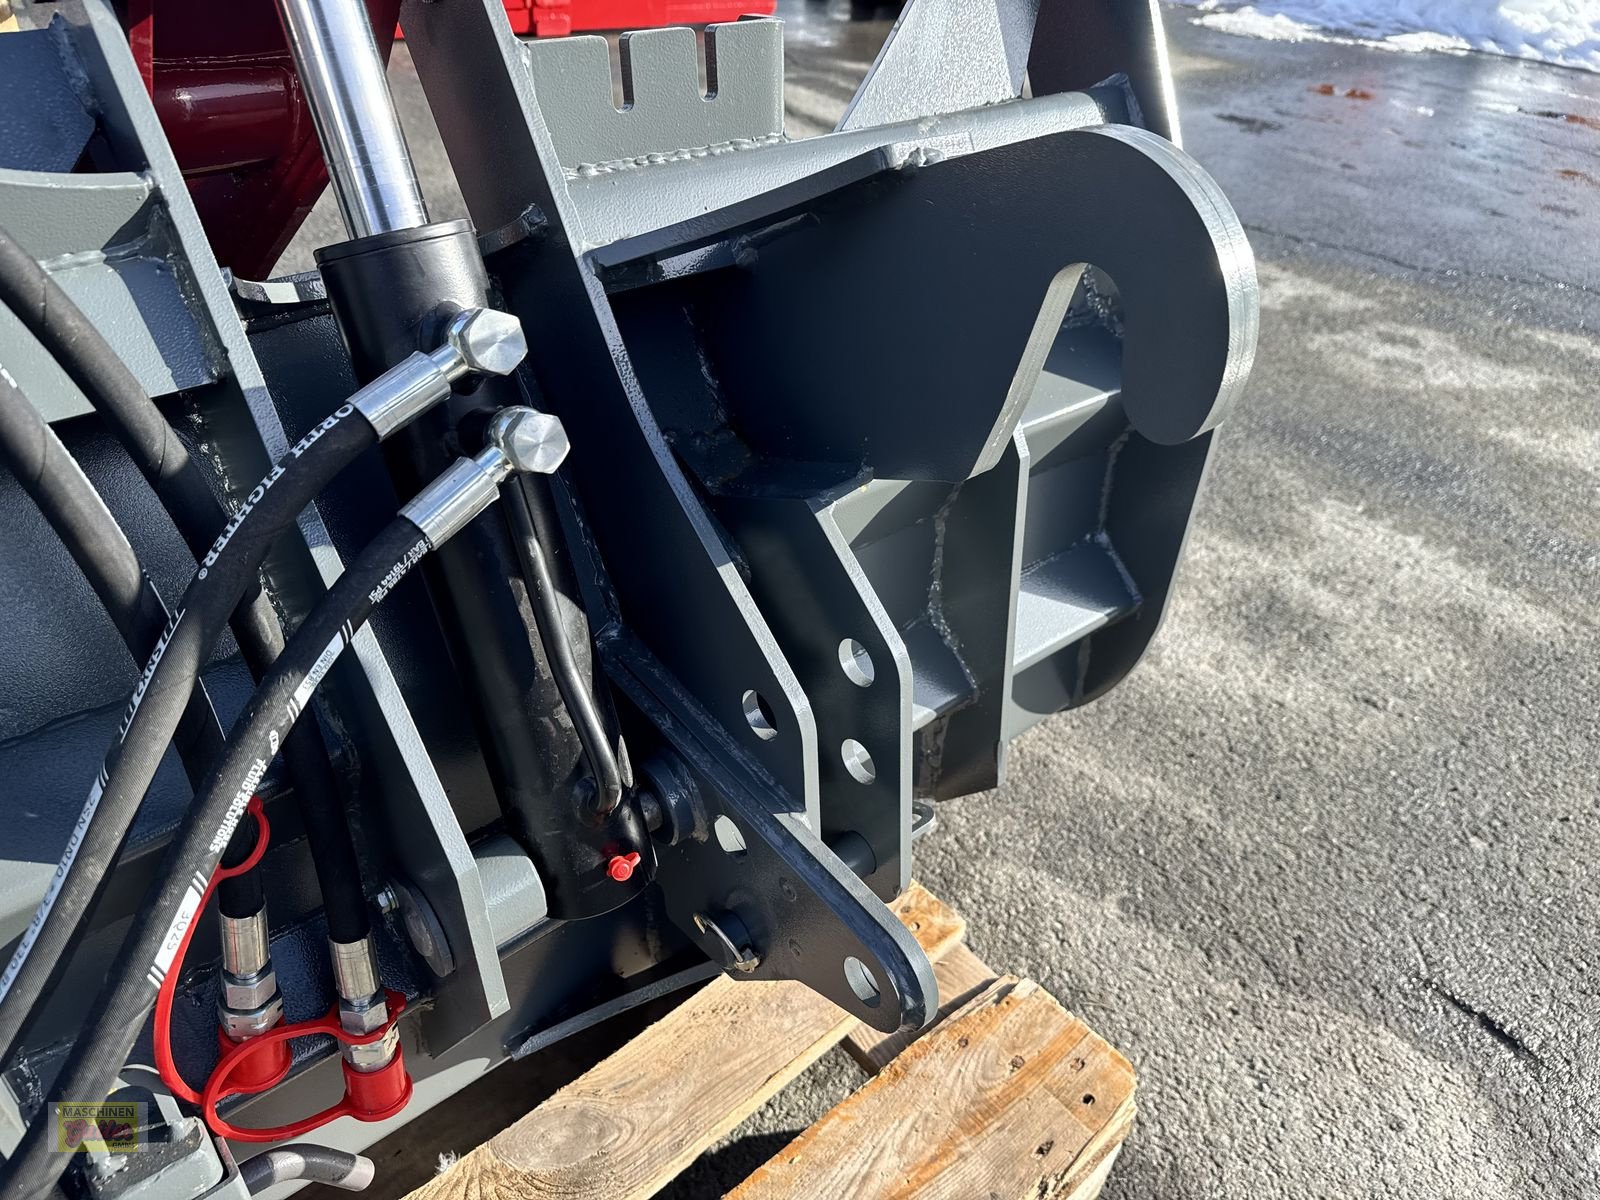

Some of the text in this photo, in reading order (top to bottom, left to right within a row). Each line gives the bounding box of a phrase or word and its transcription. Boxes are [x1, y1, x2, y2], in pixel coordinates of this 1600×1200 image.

[408, 539, 426, 557] BAR
[381, 561, 404, 586] 19144
[368, 584, 383, 600] PSI
[319, 649, 332, 664] DIN
[311, 663, 322, 675] EN
[208, 757, 263, 853] FLUID SOLUTIONS
